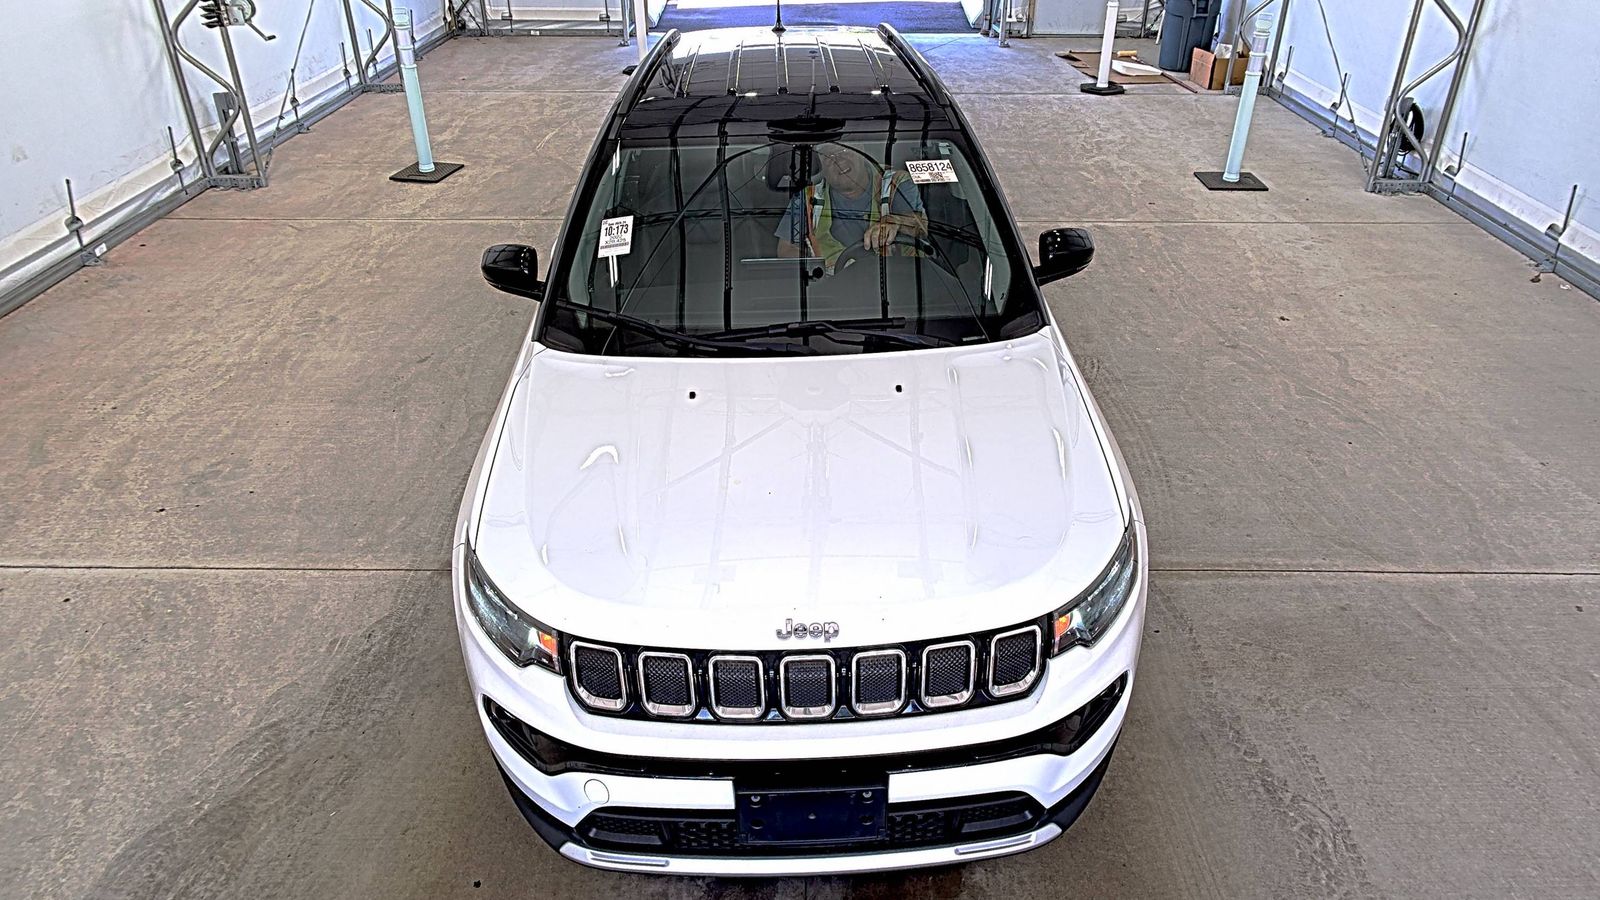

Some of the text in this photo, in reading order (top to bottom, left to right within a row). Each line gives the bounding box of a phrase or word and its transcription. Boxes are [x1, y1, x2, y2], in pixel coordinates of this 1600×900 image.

[909, 162, 952, 172] 8658124
[604, 224, 629, 237] 10:173
[776, 618, 839, 643] Jeep
